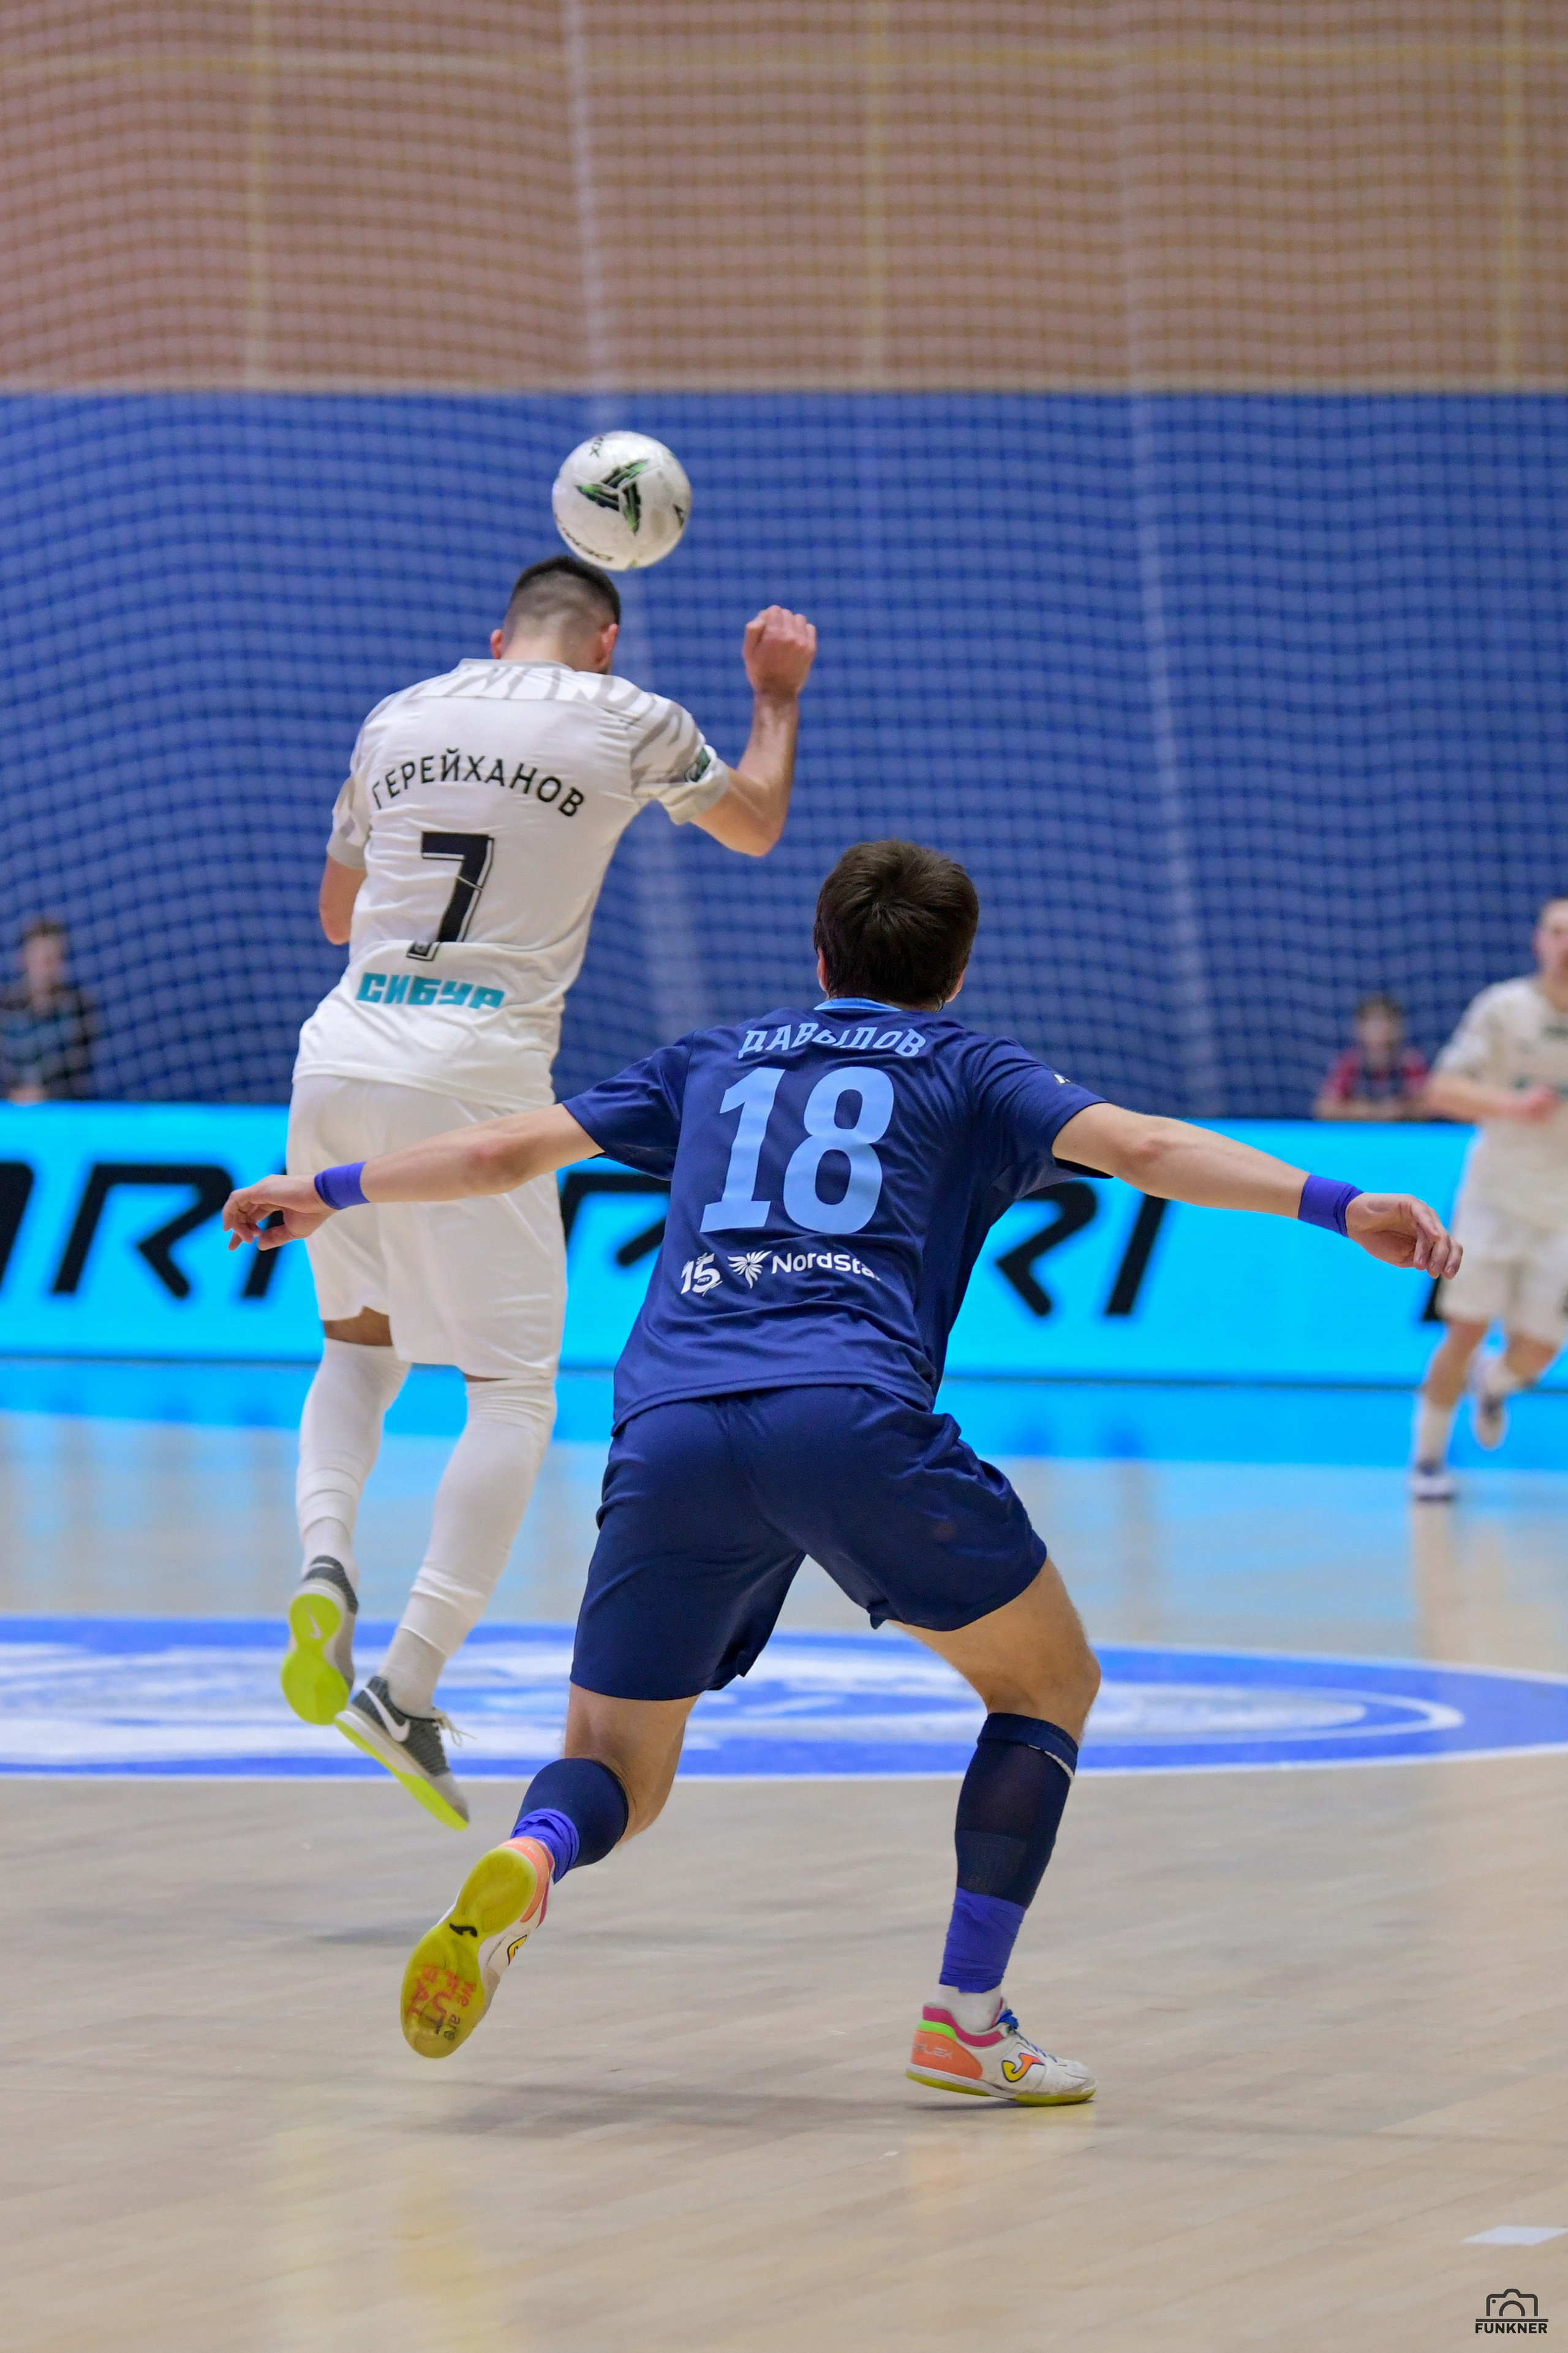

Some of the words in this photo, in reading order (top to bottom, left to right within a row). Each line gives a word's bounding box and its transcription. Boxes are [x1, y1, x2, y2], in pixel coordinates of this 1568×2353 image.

[372, 748, 585, 817] ГЕРЕЙХАНОВ
[406, 831, 495, 961] 7
[356, 972, 505, 1009] СИБУР
[738, 1022, 926, 1059] ДАВЫДОВ
[699, 1066, 894, 1234] 18
[680, 1252, 723, 1297] 15
[772, 1252, 881, 1281] NordSta
